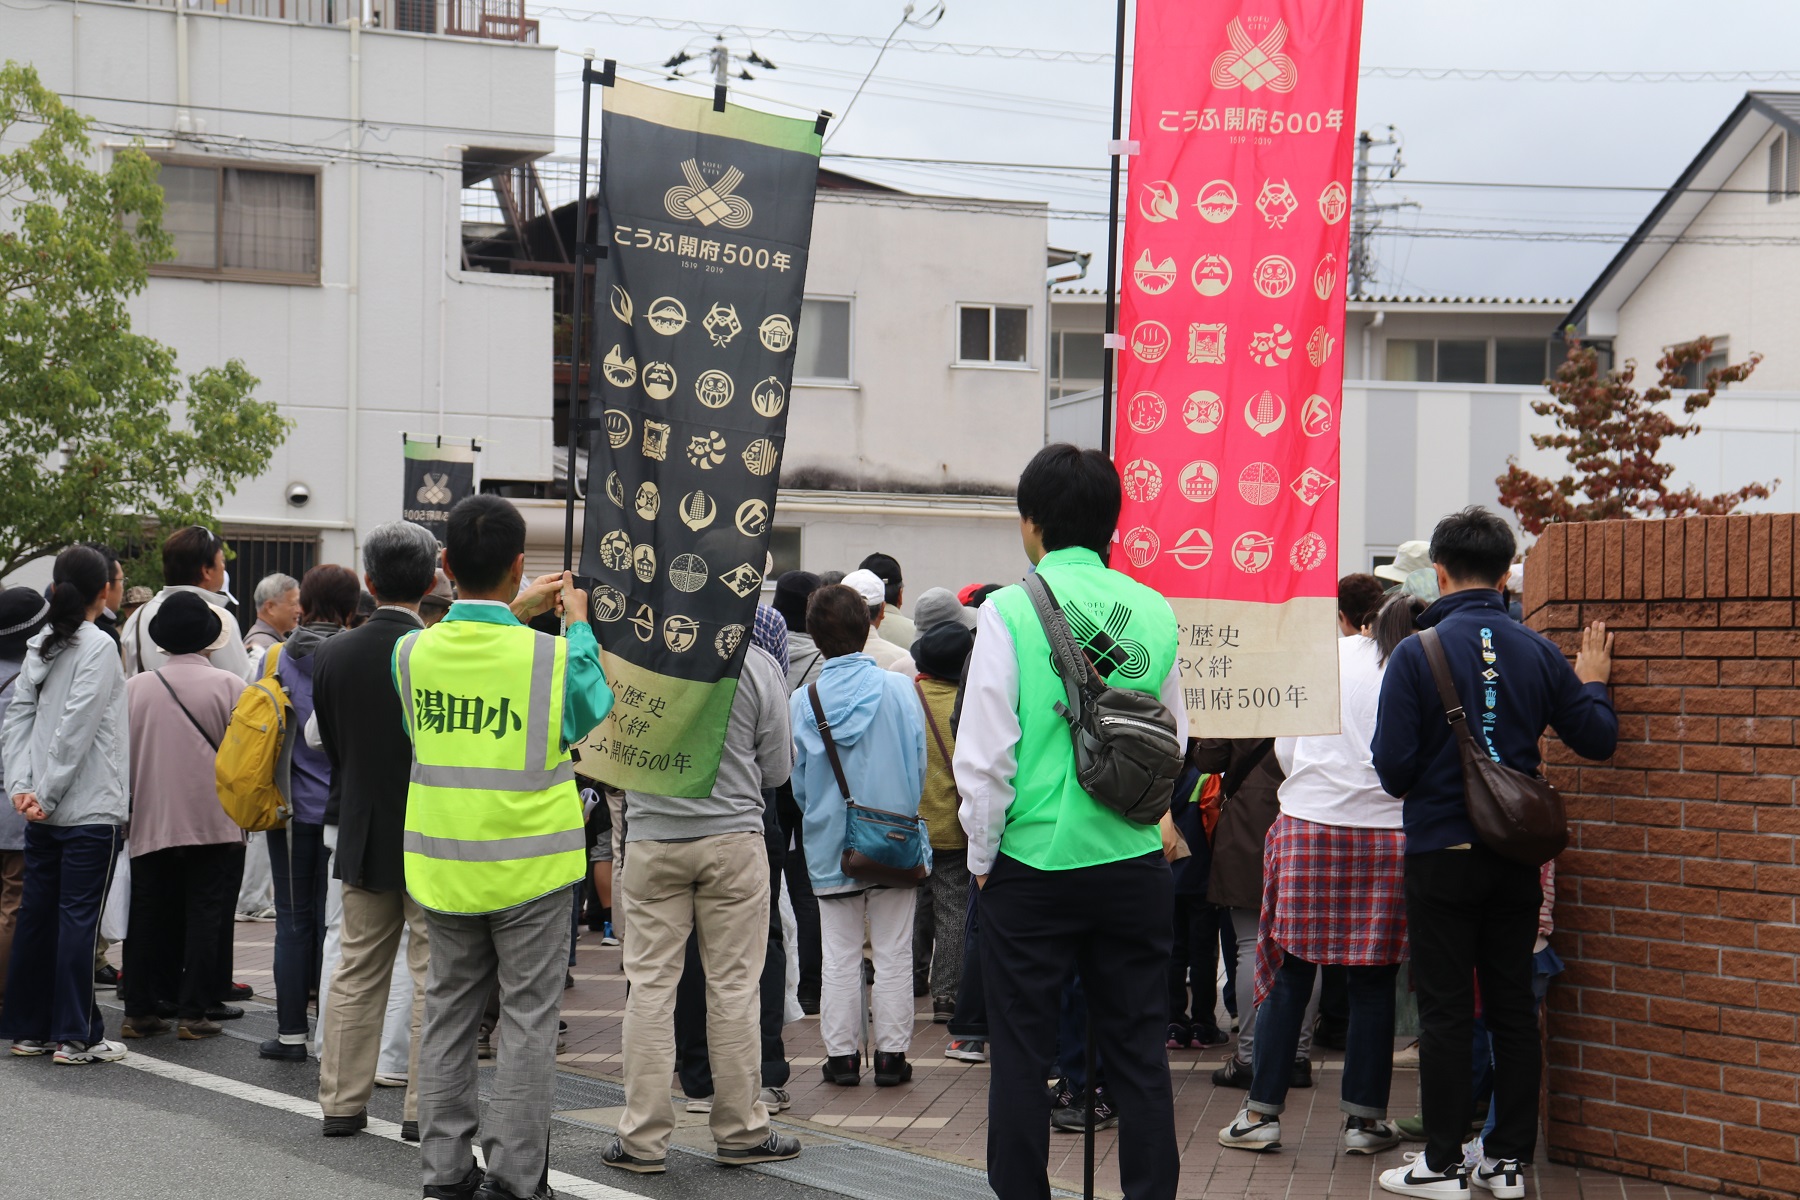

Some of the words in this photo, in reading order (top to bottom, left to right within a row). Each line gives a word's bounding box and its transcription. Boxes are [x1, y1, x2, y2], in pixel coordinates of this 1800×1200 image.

[1247, 15, 1270, 24] KOFU
[1248, 23, 1268, 31] CITY
[1158, 107, 1344, 134] こうふ開府500年
[1229, 136, 1246, 144] 1519
[1253, 137, 1272, 146] 2019
[614, 225, 791, 272] こうふ開府500年
[681, 260, 698, 269] 1519
[705, 264, 724, 274] 2019
[606, 680, 666, 718] ぐ歴史
[1184, 685, 1308, 711] 開府500年
[415, 689, 522, 739] 湯田小
